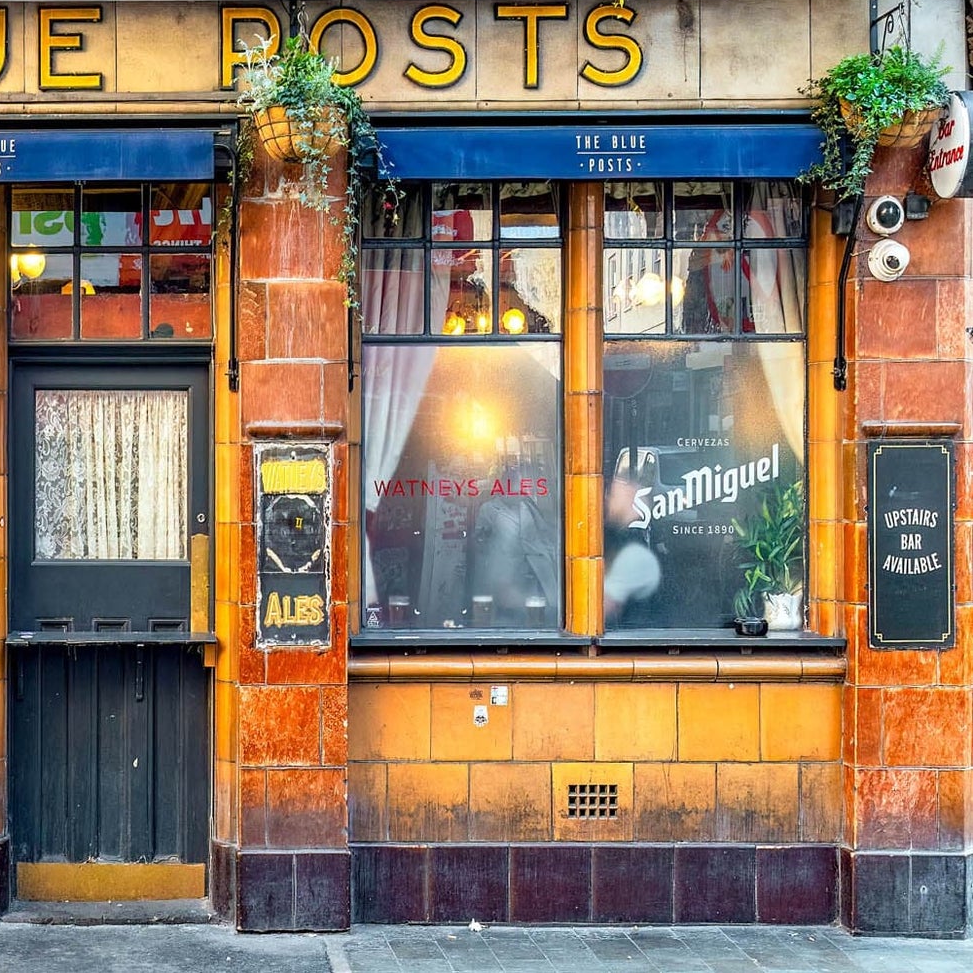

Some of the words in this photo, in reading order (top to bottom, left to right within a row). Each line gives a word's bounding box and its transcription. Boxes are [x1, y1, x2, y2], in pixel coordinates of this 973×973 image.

[220, 3, 646, 91] POSTS
[575, 134, 604, 149] THE
[612, 134, 646, 149] BLUE
[589, 157, 632, 173] POSTS
[677, 437, 730, 448] CERVEZAS
[374, 479, 479, 497] WATNEYS
[490, 478, 549, 496] ALES
[884, 508, 938, 529] UPSTAIRS
[672, 525, 704, 535] SINCE
[707, 525, 734, 535] 1890
[900, 533, 922, 551] BAR
[882, 552, 942, 575] AVAILABLE
[264, 592, 325, 627] ALES
